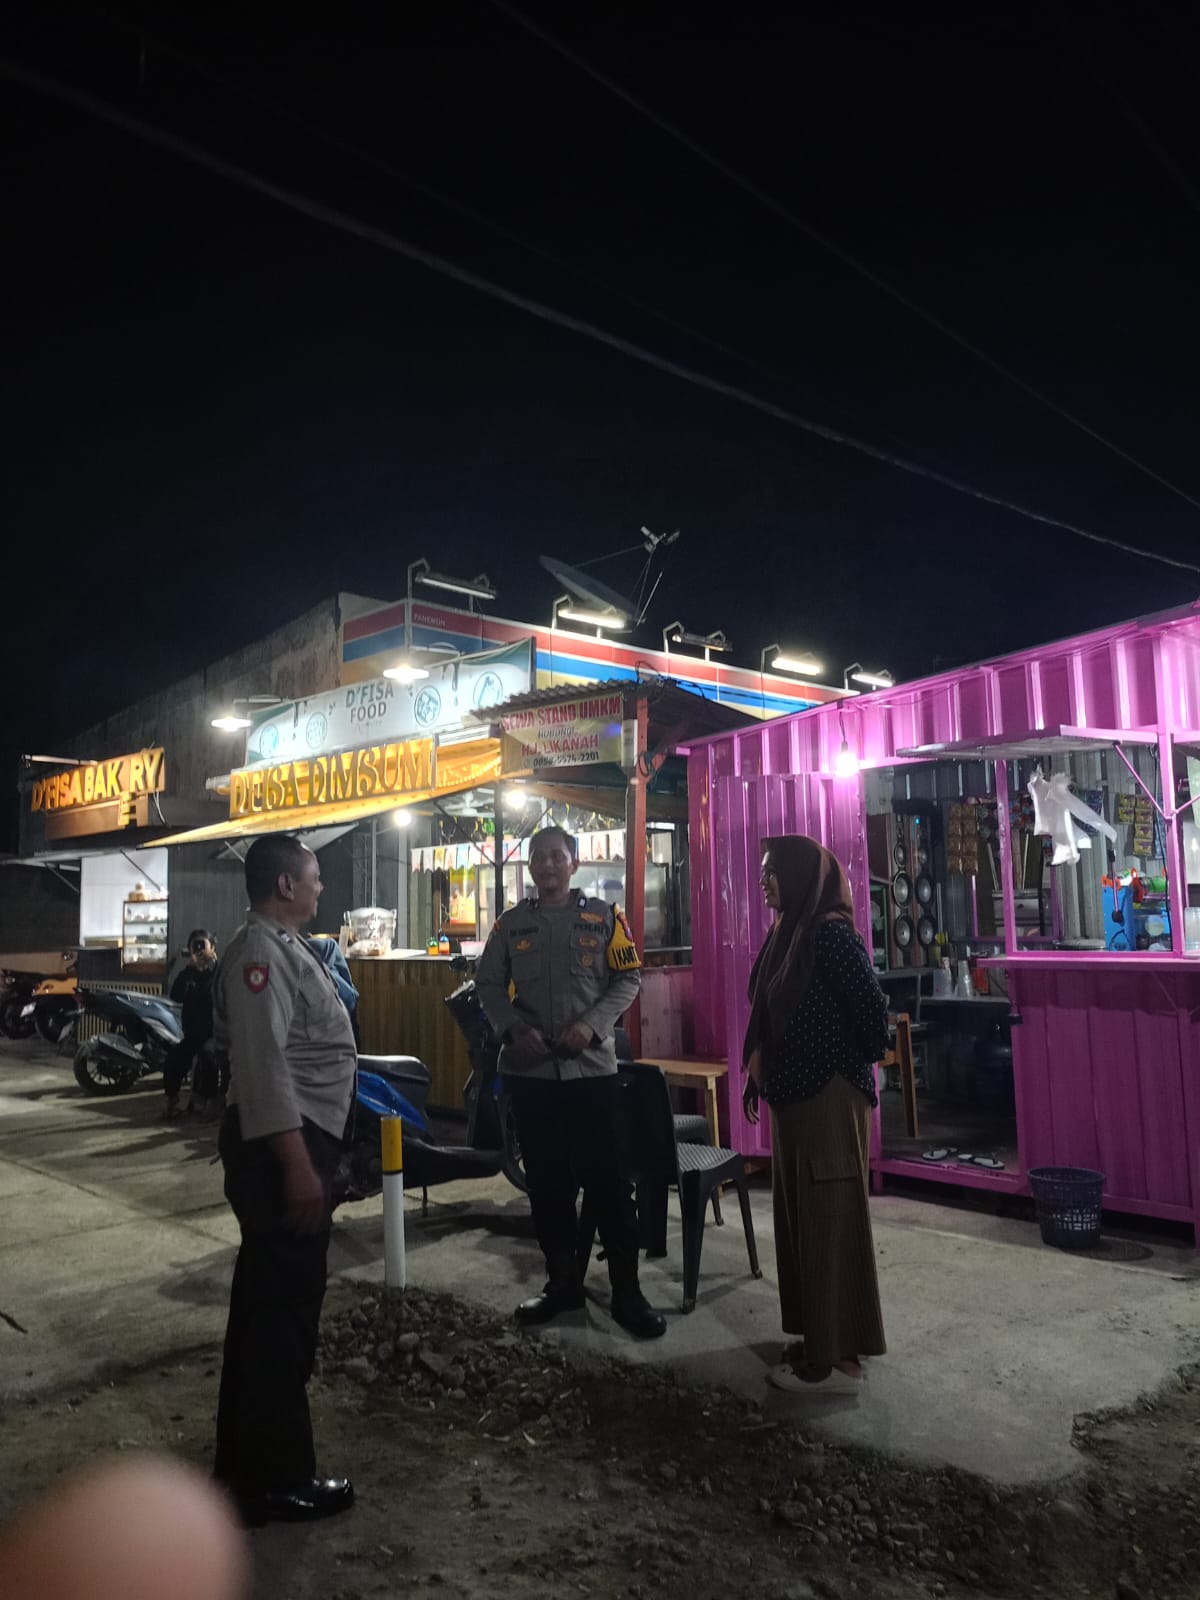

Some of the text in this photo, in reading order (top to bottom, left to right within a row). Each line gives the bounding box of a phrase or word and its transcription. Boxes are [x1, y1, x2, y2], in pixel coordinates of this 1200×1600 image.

[346, 681, 394, 708] D'FISA
[350, 702, 387, 723] FOOD
[579, 695, 621, 719] UMKM
[543, 734, 599, 754] LIKANAH
[308, 737, 434, 803] DIMSUM
